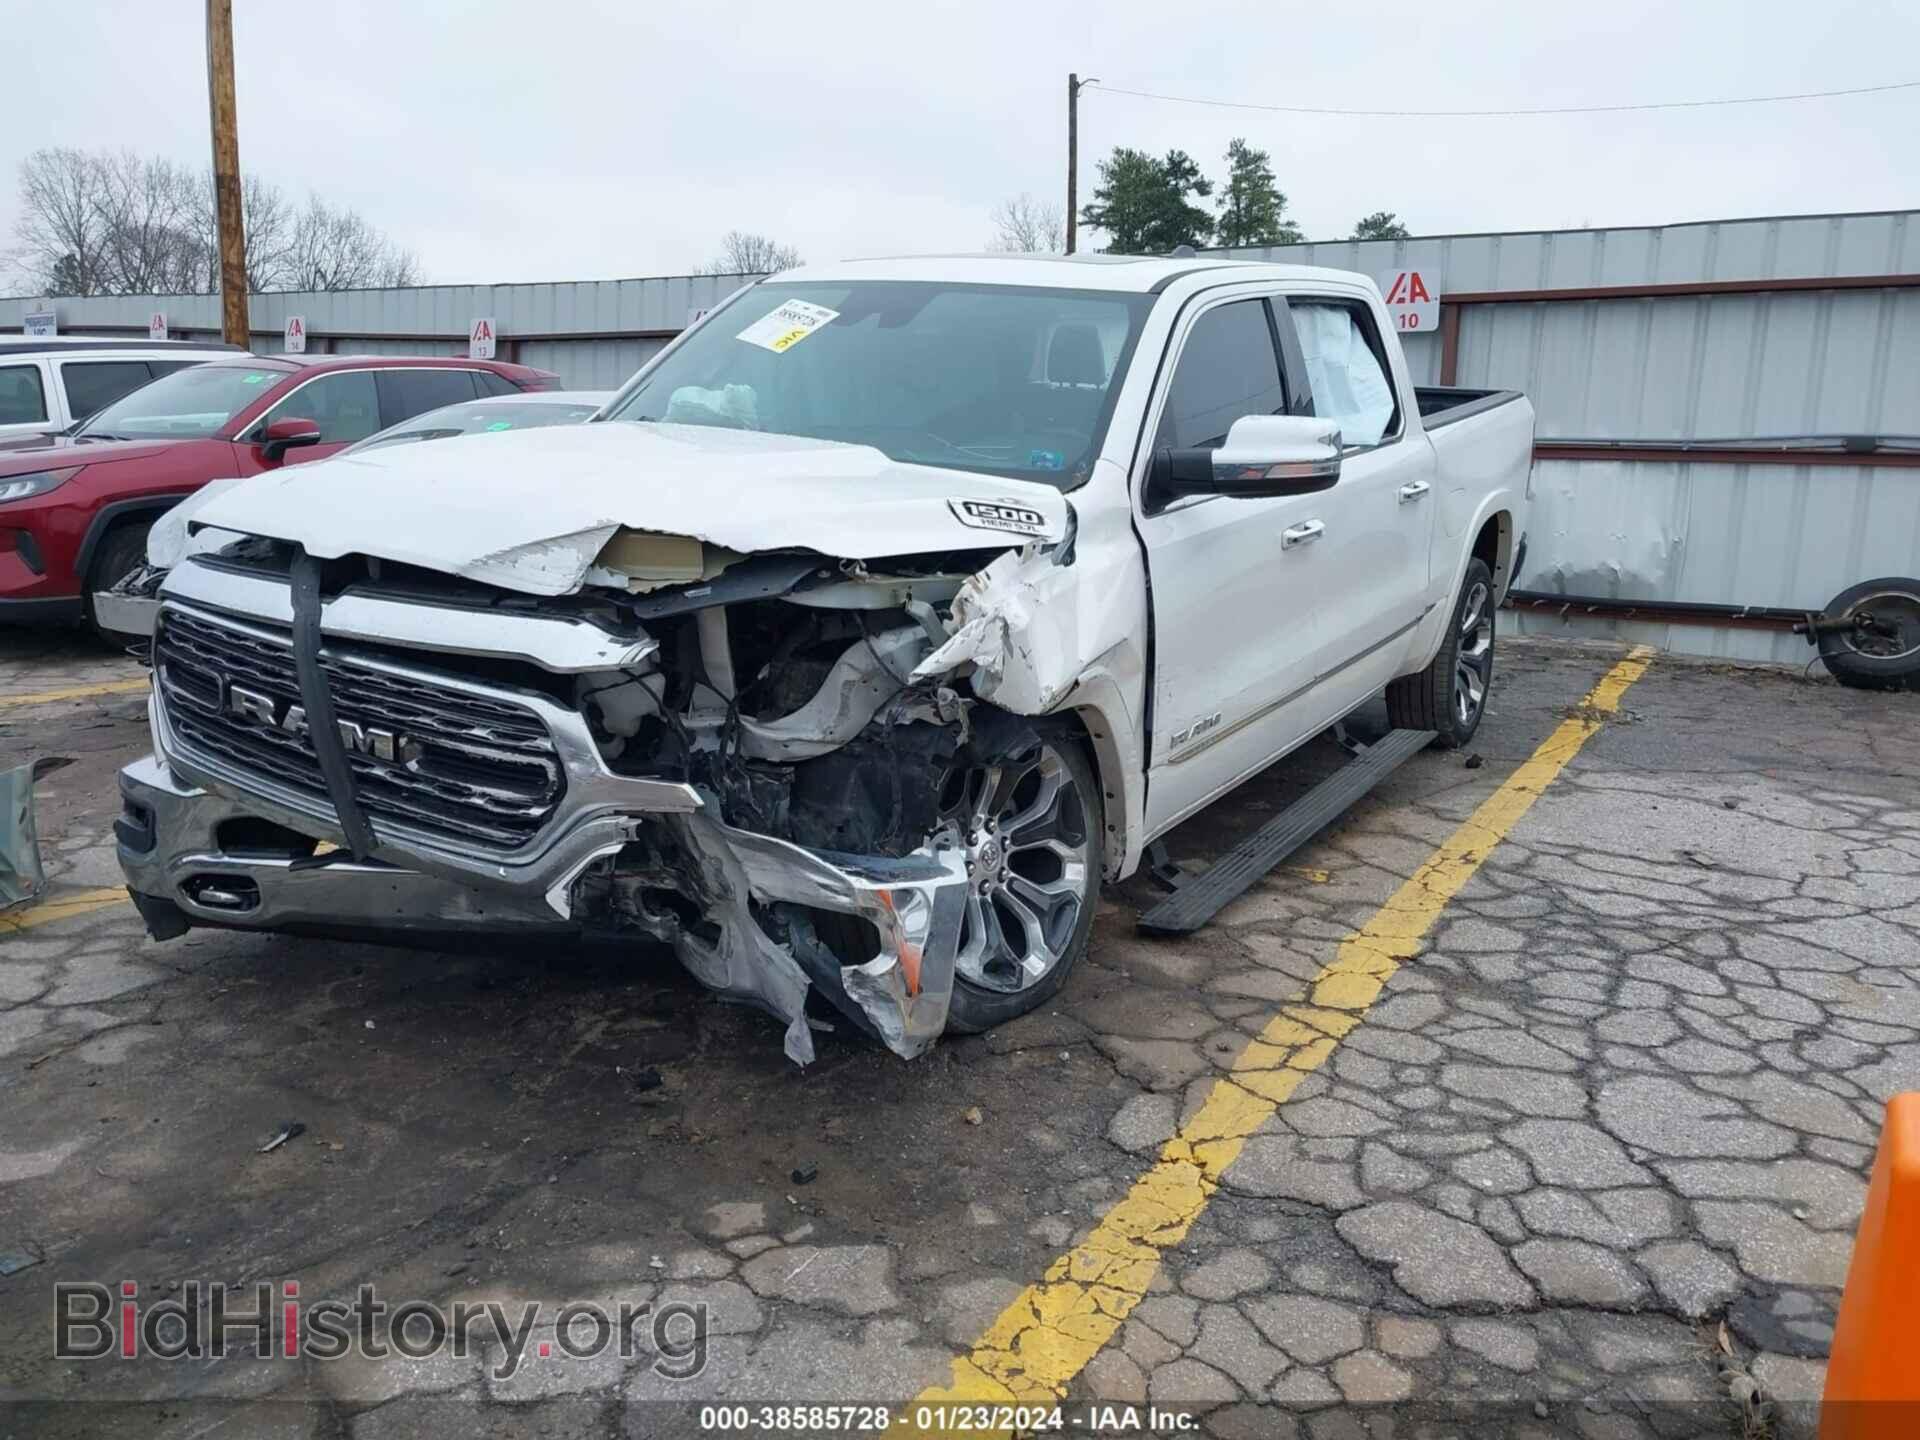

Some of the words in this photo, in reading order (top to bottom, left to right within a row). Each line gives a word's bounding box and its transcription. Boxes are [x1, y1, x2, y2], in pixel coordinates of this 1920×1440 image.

[1399, 313, 1419, 329] 10
[966, 502, 1040, 525] 1500
[981, 518, 1013, 529] HEMI
